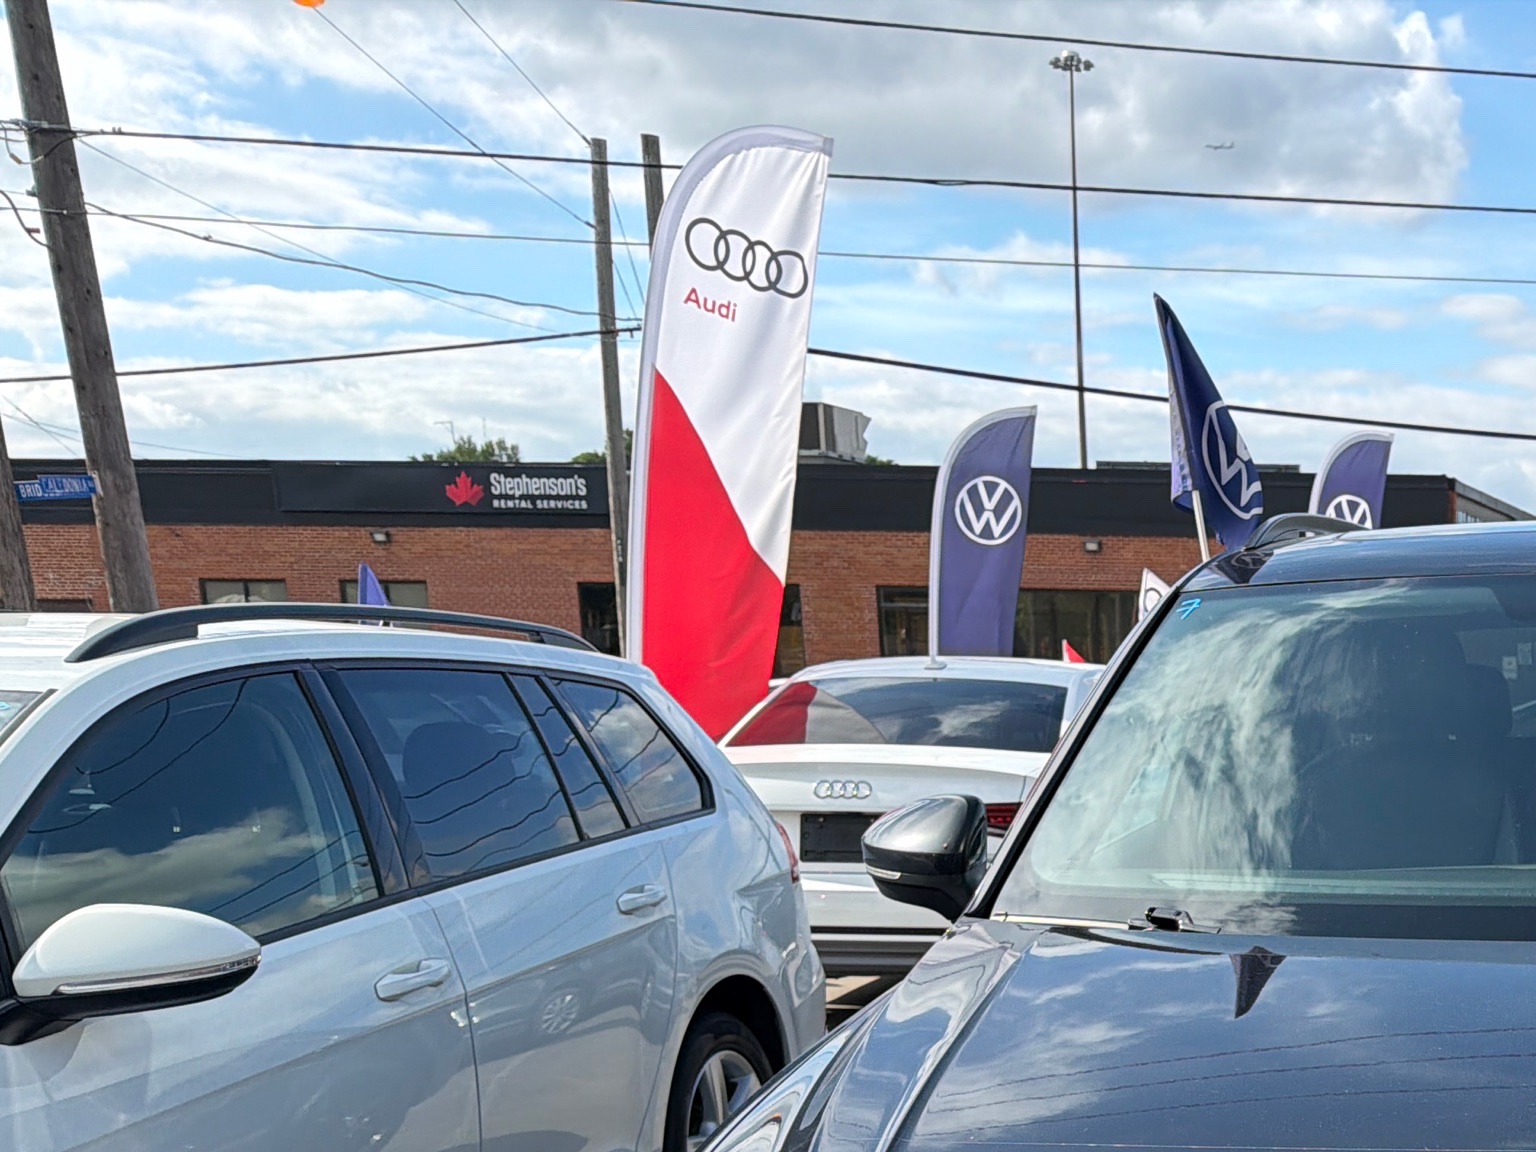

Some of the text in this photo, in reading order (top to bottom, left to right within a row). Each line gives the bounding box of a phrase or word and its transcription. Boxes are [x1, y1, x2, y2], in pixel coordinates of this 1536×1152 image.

[683, 286, 737, 323] Audi
[489, 472, 588, 498] Stephenson's
[492, 499, 588, 510] RENTAL SERVICES
